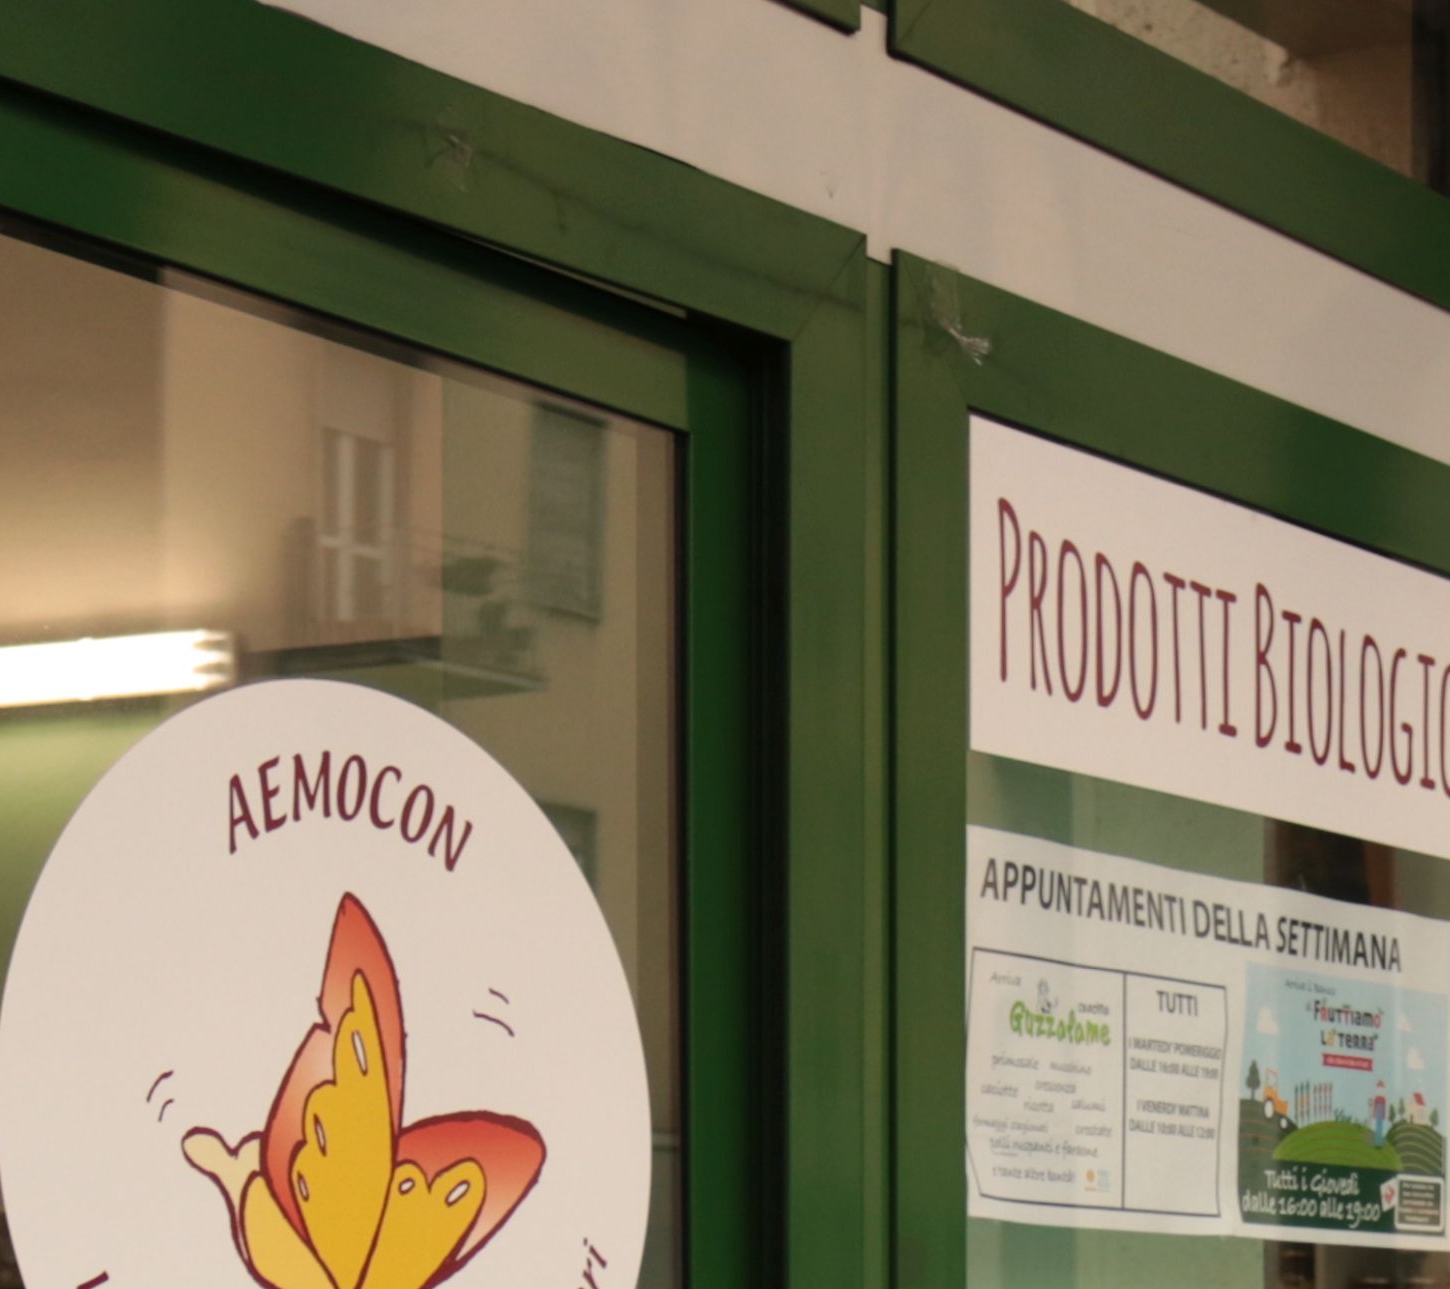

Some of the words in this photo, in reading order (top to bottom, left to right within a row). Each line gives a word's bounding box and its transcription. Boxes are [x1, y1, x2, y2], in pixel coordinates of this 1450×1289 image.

[998, 497, 1237, 738] PRODOTTI
[224, 751, 474, 871] AEMOCON
[980, 858, 1185, 936] APPUNTAMENTI
[1193, 901, 1270, 950] DELLA
[1276, 916, 1401, 972] SETTIMANA
[1156, 990, 1198, 1016] TUTTI
[1130, 1057, 1156, 1072] DALLE
